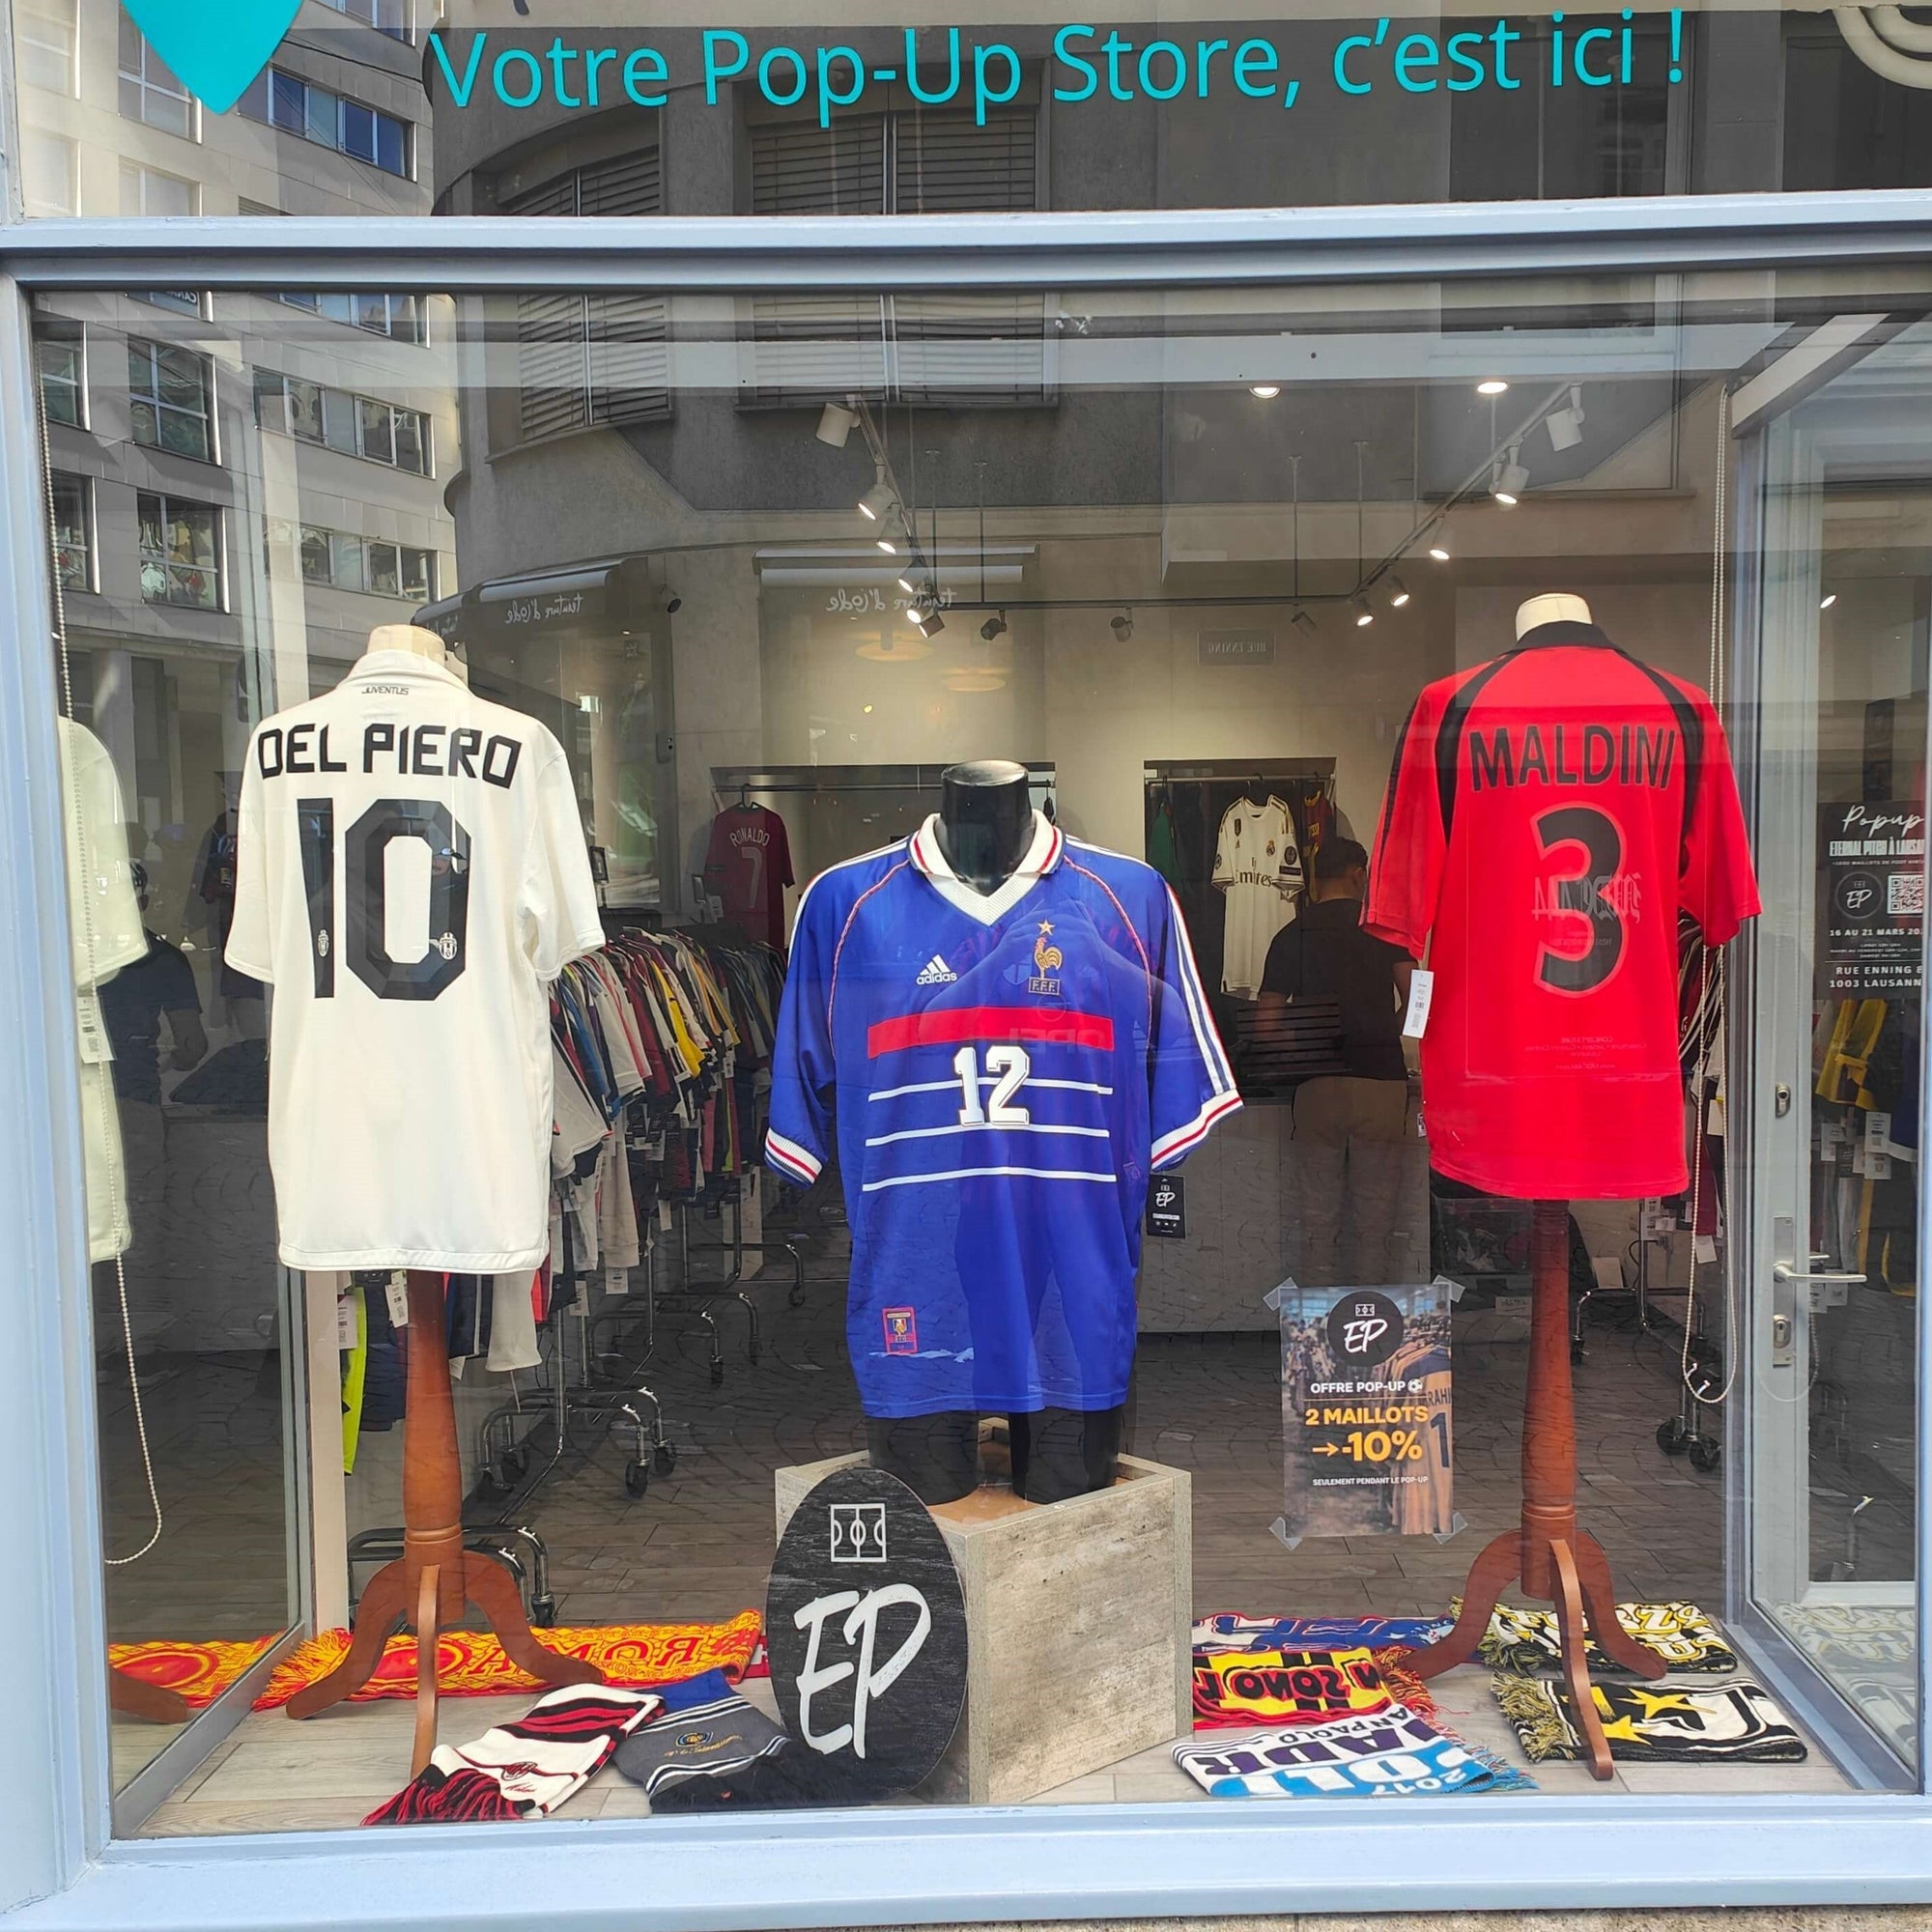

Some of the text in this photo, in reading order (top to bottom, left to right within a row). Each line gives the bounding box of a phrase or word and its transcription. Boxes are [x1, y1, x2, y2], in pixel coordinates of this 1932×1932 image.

[429, 32, 669, 108] Votre
[702, 27, 1022, 128] Pop-Up
[1053, 24, 1300, 109] Store,
[1333, 17, 1521, 96] c'est
[1550, 8, 1634, 87] ici
[361, 686, 410, 696] JUVENTUS
[257, 723, 523, 790] DEL PIERO
[1468, 724, 1676, 792] MALDINI
[1841, 805, 1924, 838] Popup
[729, 827, 771, 847] RONALDO
[741, 846, 763, 909] 7
[296, 797, 471, 1002] 10
[1529, 800, 1628, 999] 3
[1846, 889, 1873, 909] EP
[916, 972, 957, 985] adidas
[1829, 979, 1922, 988] 1003 LAUSANN
[1835, 966, 1860, 975] RUE
[1864, 966, 1913, 975] ENNING
[952, 1044, 1031, 1127] 12
[1154, 1191, 1176, 1208] EP
[1342, 1318, 1389, 1353] EP
[1310, 1379, 1406, 1394] OFFRE POP-UP
[1304, 1405, 1429, 1426] 2 MAILLOTS
[1342, 1429, 1423, 1463] -10%
[1312, 1475, 1429, 1487] SEULEMENT PENDANT LE POP-UP
[793, 1582, 932, 1760] EP
[1279, 1719, 1367, 1745] PAOLO
